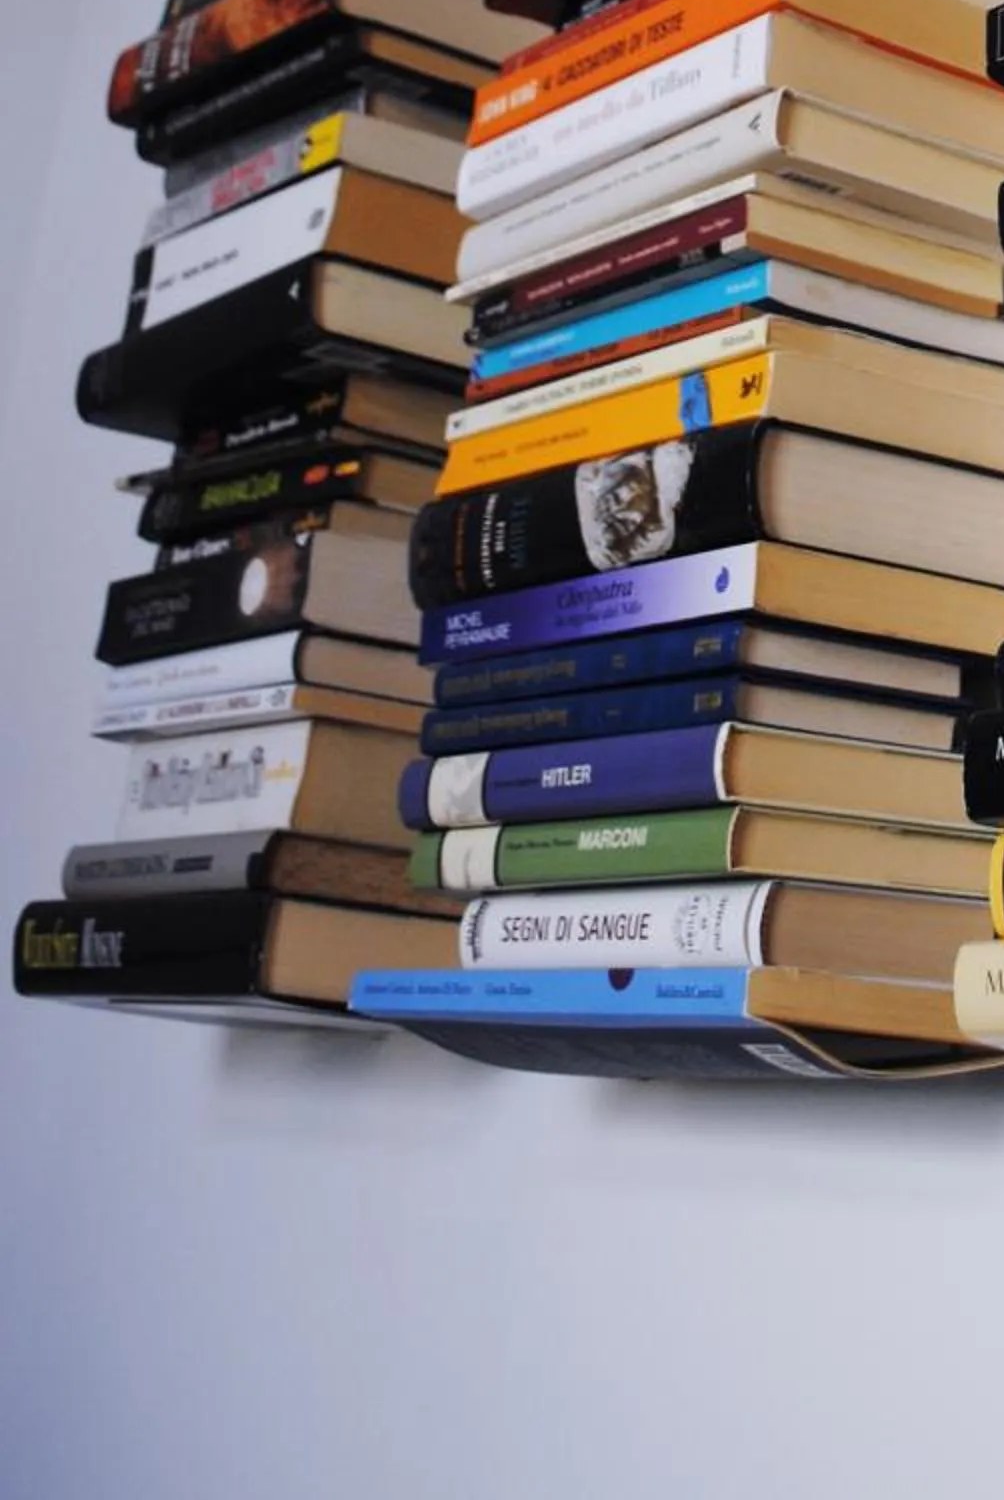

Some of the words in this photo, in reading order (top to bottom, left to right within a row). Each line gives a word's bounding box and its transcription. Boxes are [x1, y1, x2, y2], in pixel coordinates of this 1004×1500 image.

[541, 764, 592, 788] HITLER
[578, 826, 649, 851] MARCONI
[501, 915, 550, 943] SEGNI
[555, 915, 572, 941] DI
[578, 912, 652, 942] SANGUE
